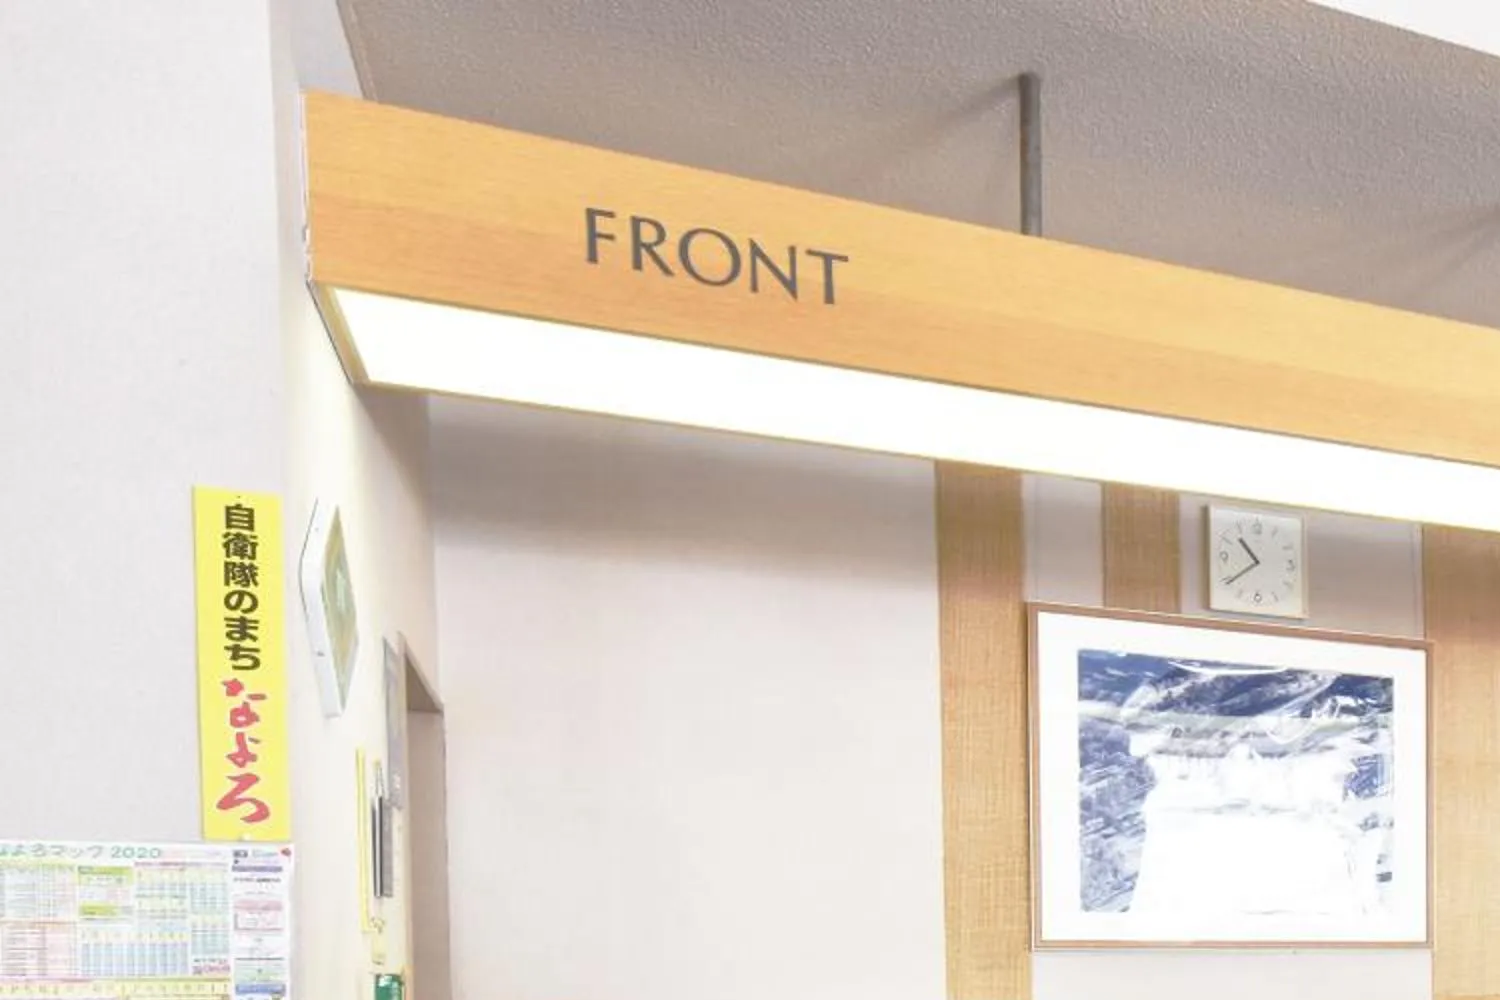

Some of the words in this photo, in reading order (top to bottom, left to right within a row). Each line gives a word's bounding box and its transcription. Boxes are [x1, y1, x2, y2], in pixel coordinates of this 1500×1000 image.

[586, 207, 849, 305] FRONT
[222, 503, 261, 671] 自衛隊のまち
[216, 678, 270, 824] なよろ
[111, 845, 162, 860] 2020
